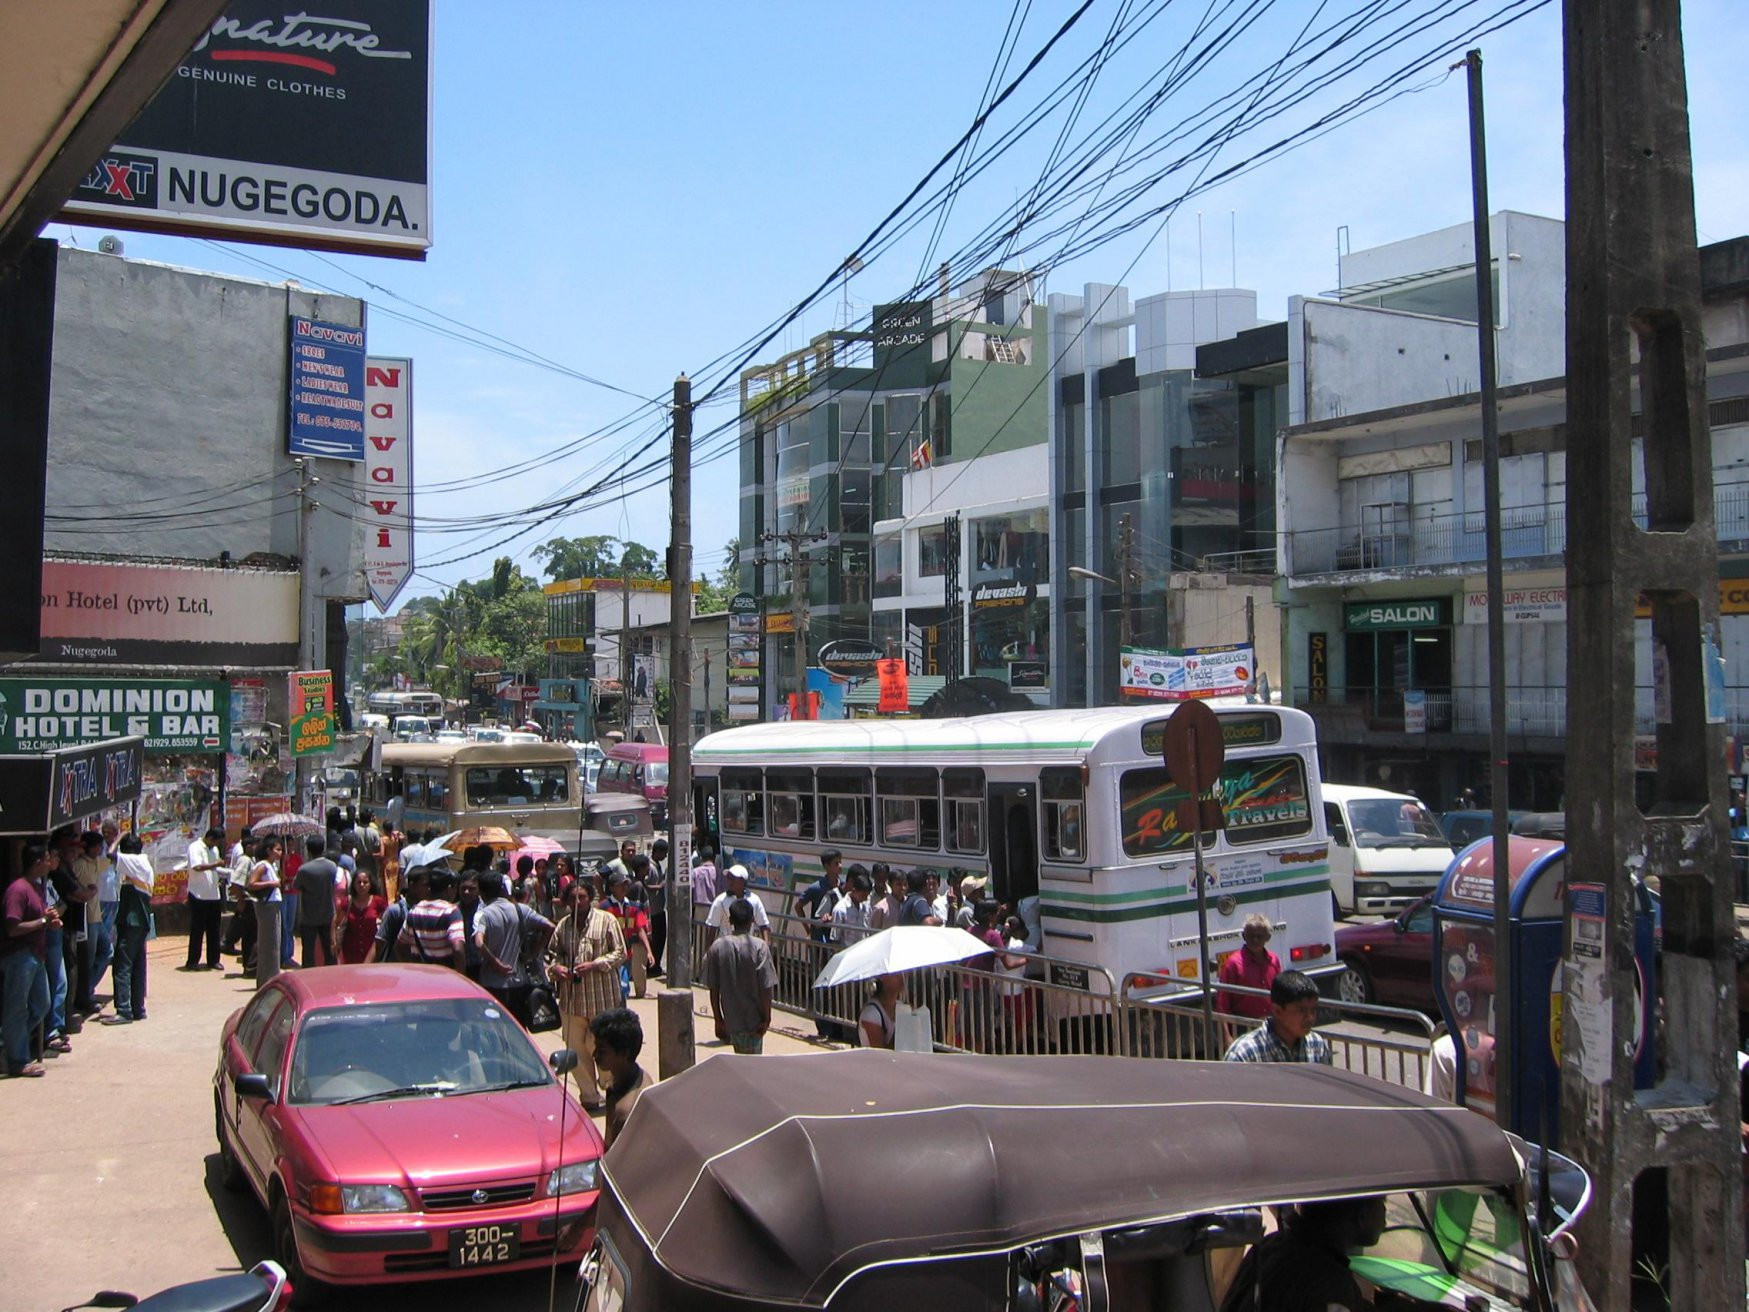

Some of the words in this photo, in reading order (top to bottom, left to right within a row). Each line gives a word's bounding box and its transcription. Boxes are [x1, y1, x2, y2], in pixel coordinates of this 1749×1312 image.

[178, 66, 257, 88] GENUINE
[267, 79, 347, 100] CLOTHES
[168, 166, 419, 230] NUGEGODA.
[298, 321, 363, 346] Navavi
[877, 333, 925, 347] ARCADE
[976, 581, 1028, 600] devashi
[66, 591, 118, 610] Hotel
[127, 594, 169, 615] (pvt)
[178, 596, 213, 616] Ltd,
[1370, 606, 1435, 624] SALON
[61, 644, 118, 658] Nugegoda
[1312, 636, 1324, 702] SALON
[25, 688, 214, 714] DOMINION
[15, 716, 121, 738] HOTEL
[127, 715, 150, 736] &
[162, 715, 220, 736] BAR
[1227, 802, 1307, 826] Travels
[1170, 937, 1201, 949] LANK
[460, 1243, 509, 1265] 1442
